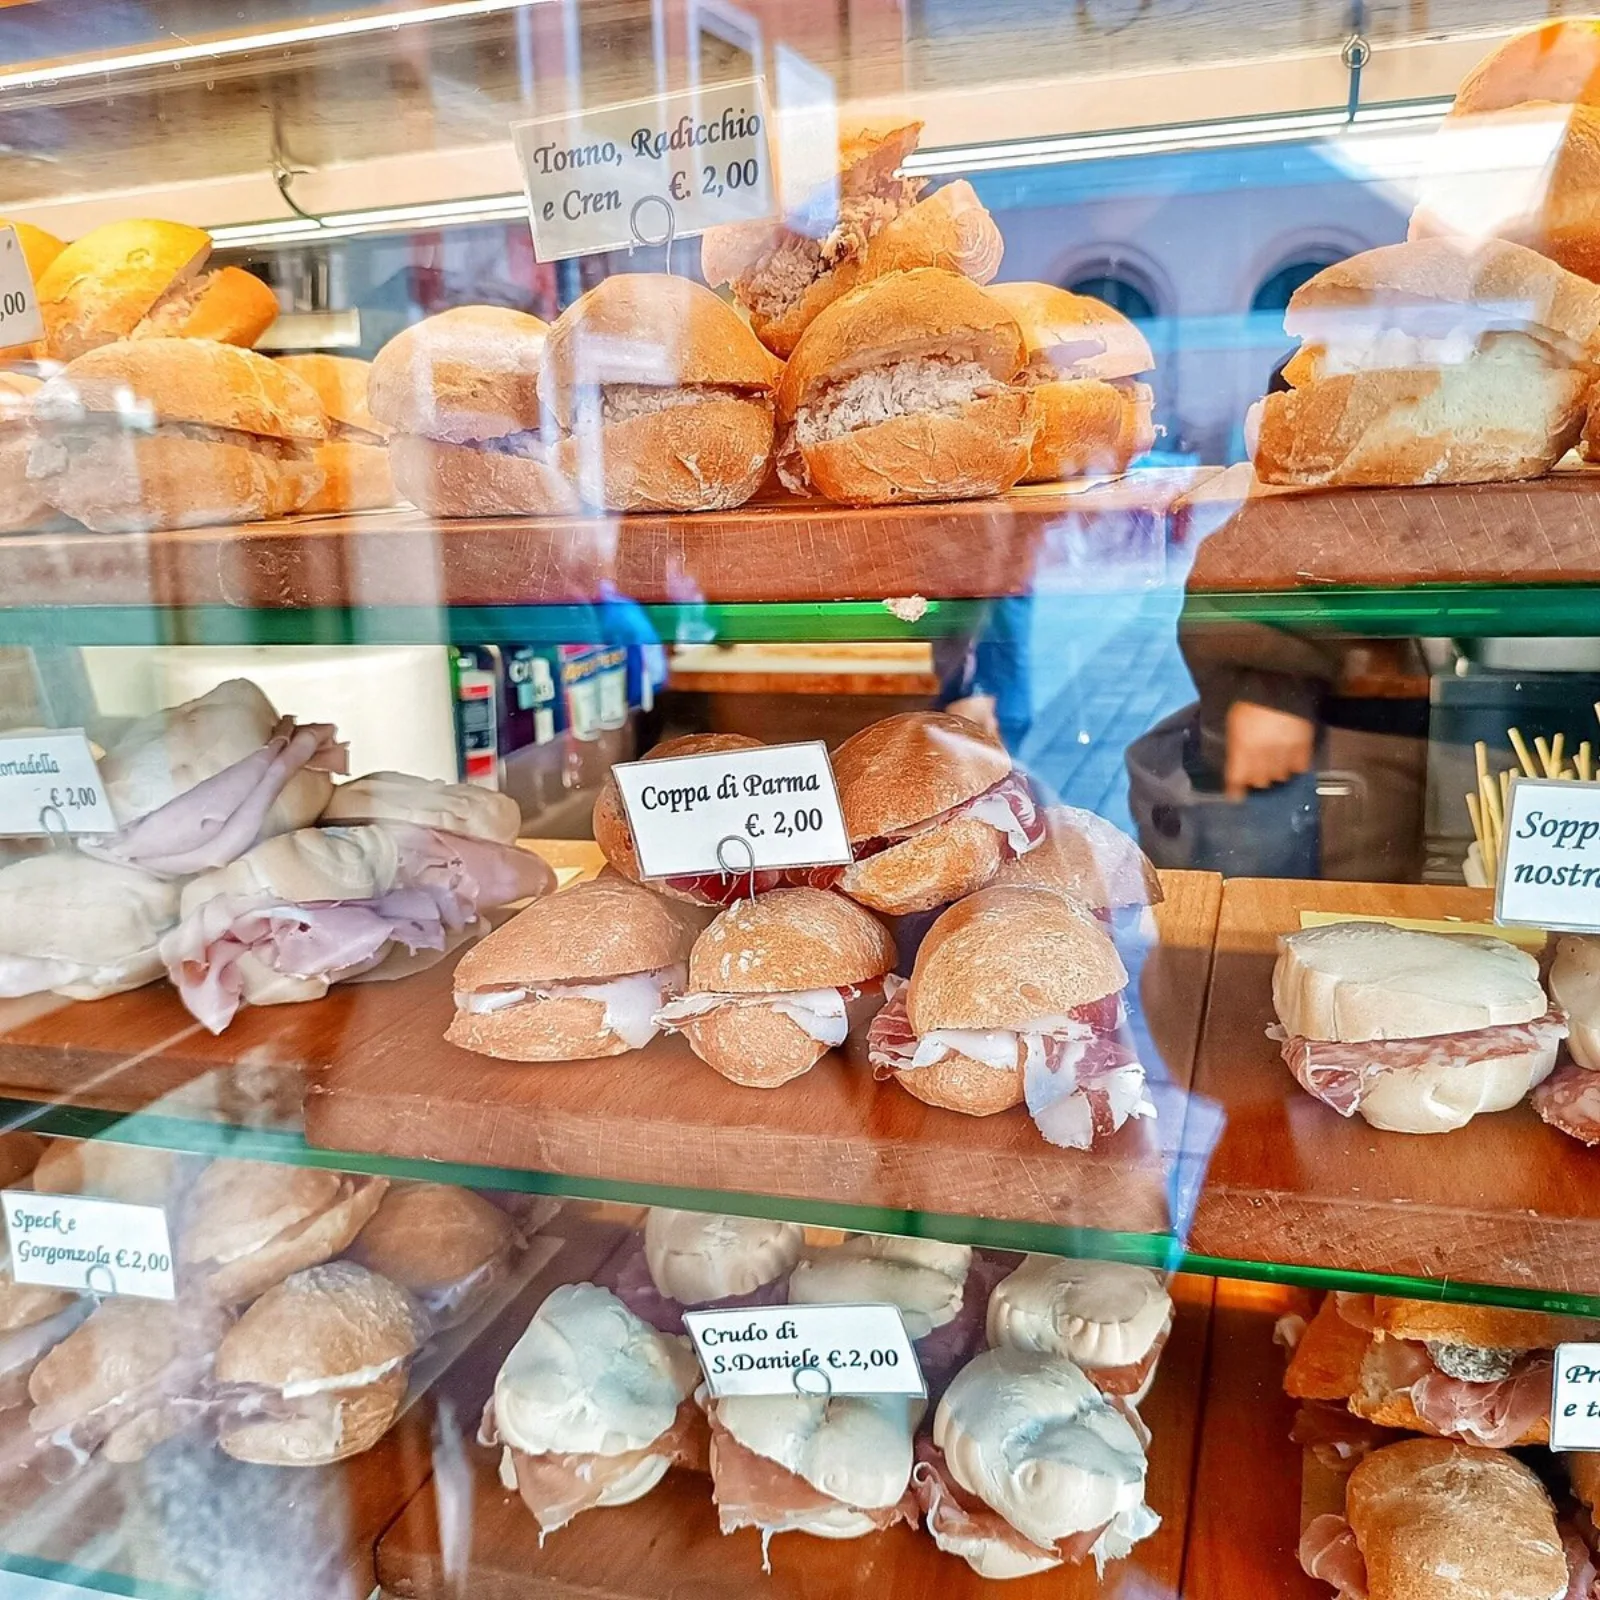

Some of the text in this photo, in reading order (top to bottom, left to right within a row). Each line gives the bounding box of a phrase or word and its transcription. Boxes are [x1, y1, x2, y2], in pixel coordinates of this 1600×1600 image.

[533, 107, 761, 174] Tonno, Radicchio
[543, 158, 760, 221] e Cren €. 2,00
[0, 752, 61, 776] ortadella
[66, 787, 97, 810] 2,00
[641, 773, 821, 813] Coppa di Parma
[773, 808, 824, 837] 2,00
[1515, 811, 1600, 850] Sopp
[12, 1208, 77, 1234] Speck e
[17, 1240, 111, 1265] Gorgonzola
[701, 1321, 799, 1346] Crudo di
[712, 1348, 899, 1374] S.Daniele €.2,00
[1565, 1364, 1600, 1384] Pr
[1563, 1400, 1600, 1417] e t
